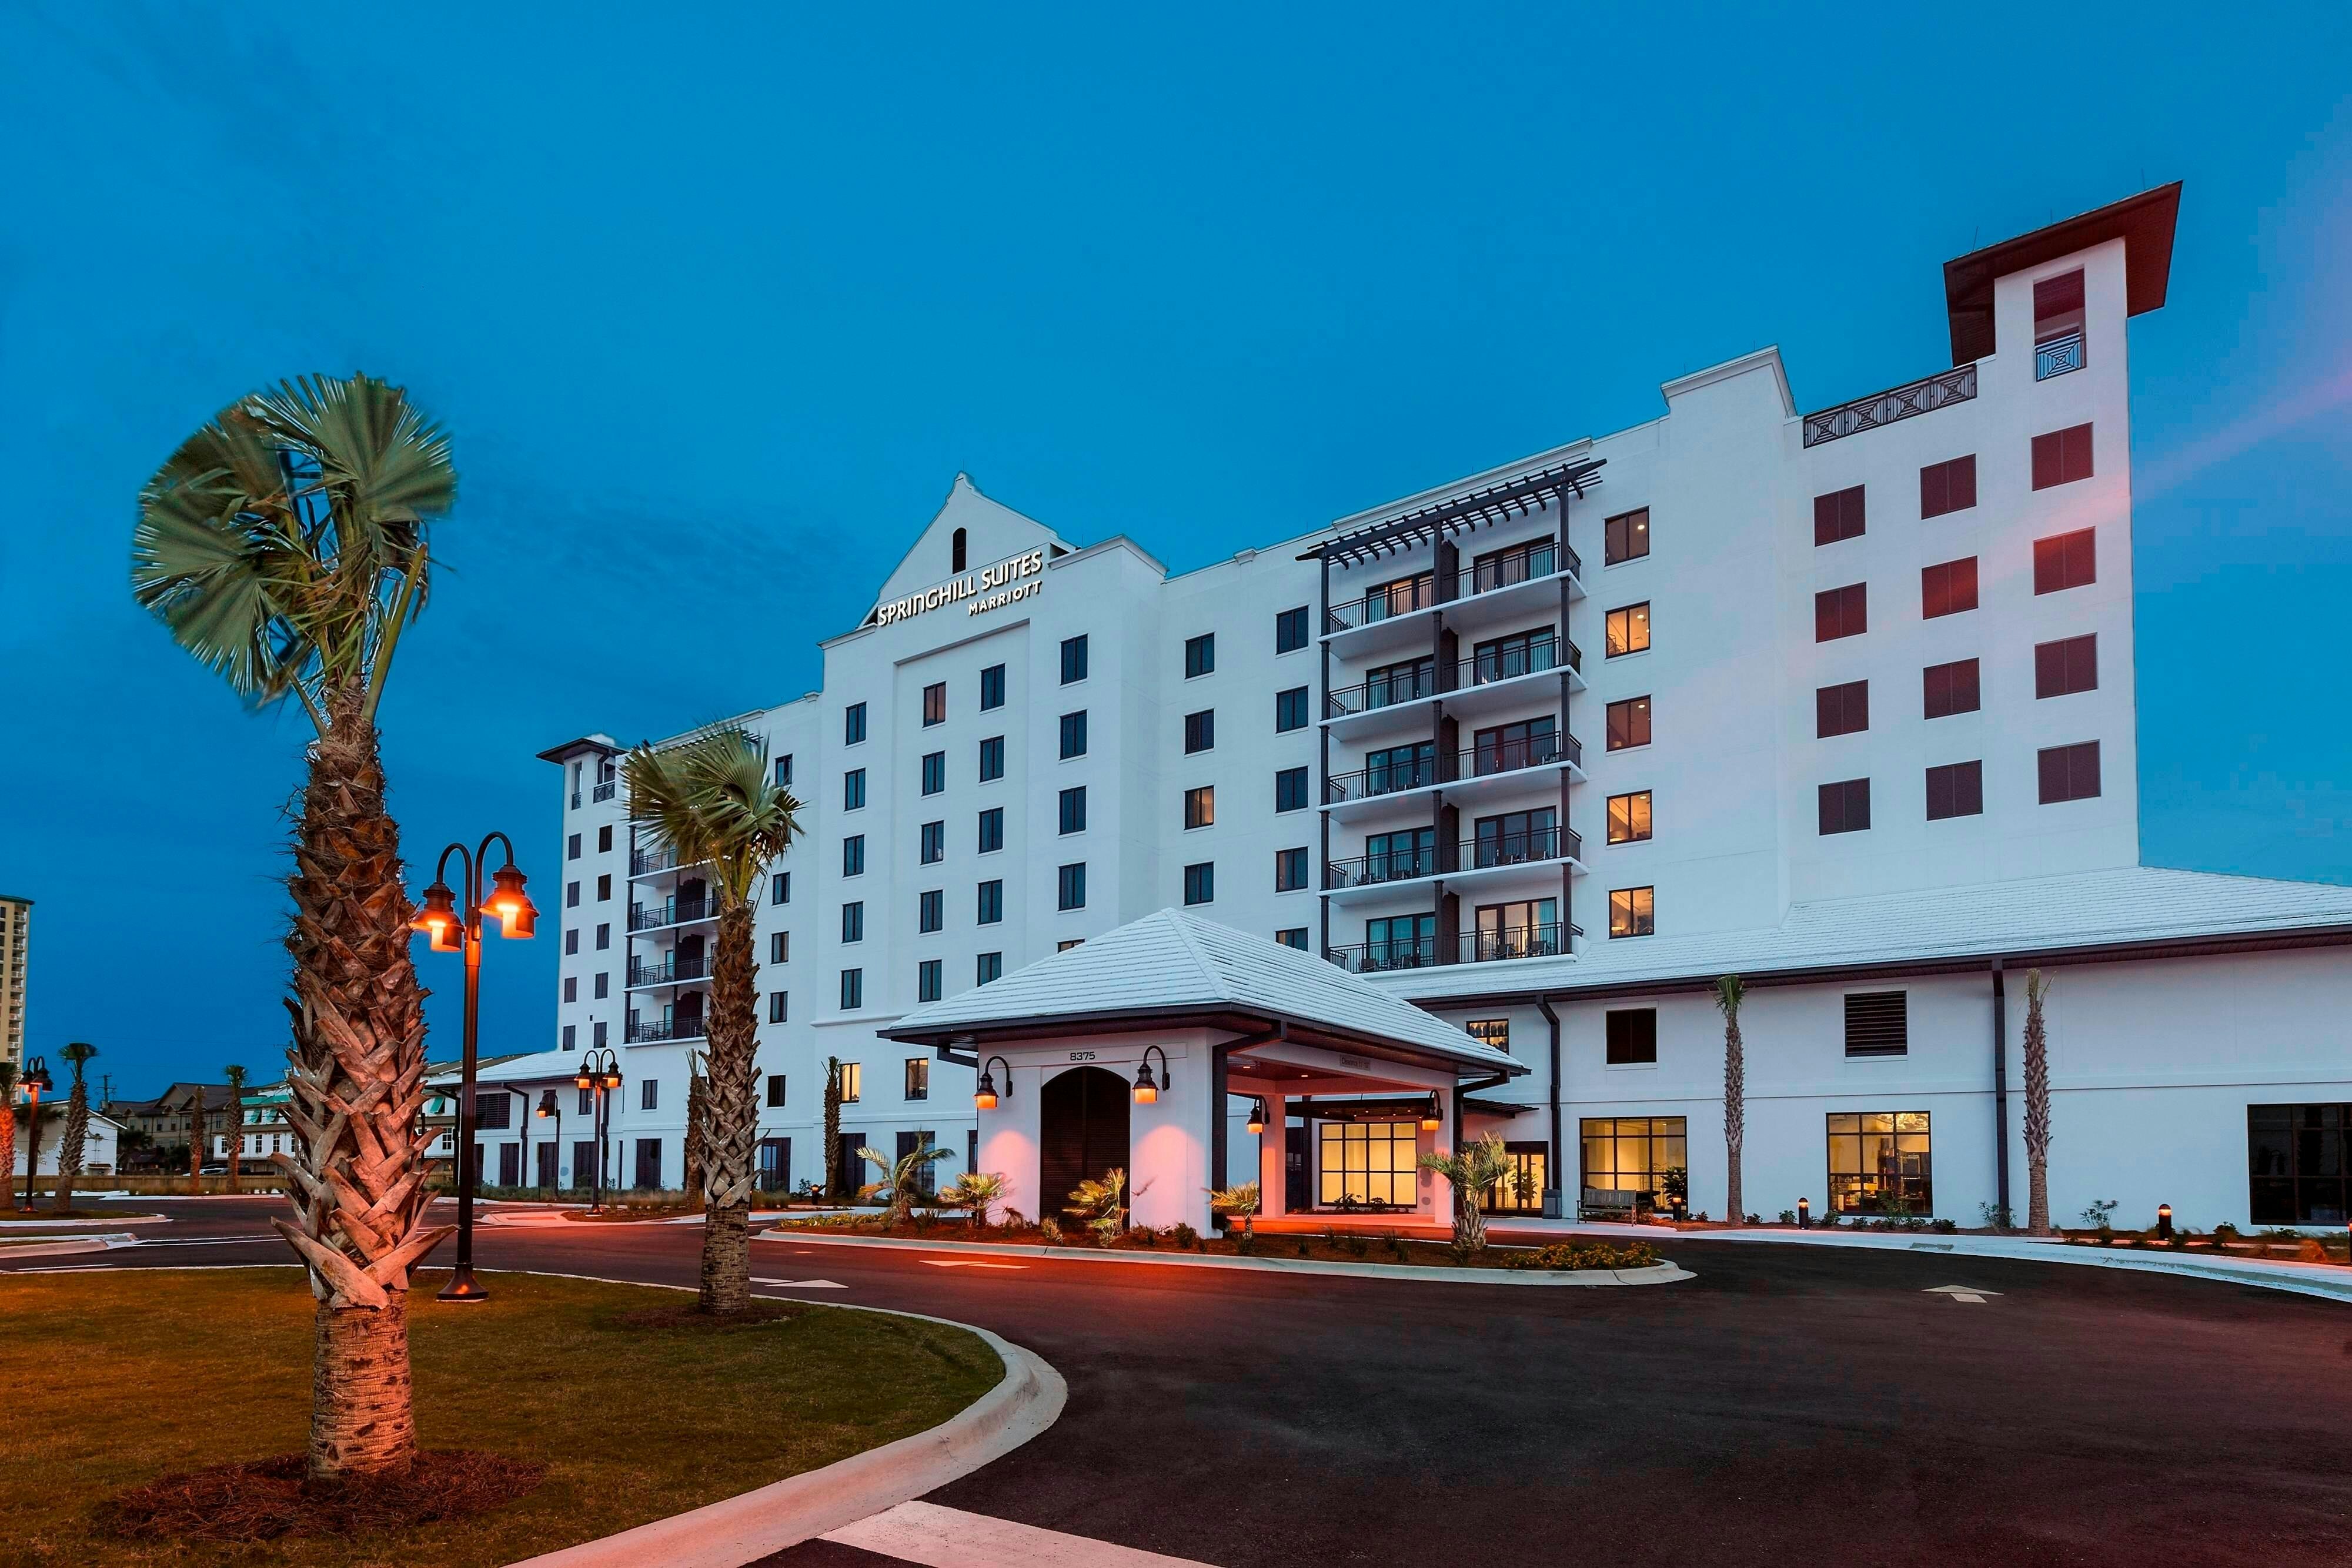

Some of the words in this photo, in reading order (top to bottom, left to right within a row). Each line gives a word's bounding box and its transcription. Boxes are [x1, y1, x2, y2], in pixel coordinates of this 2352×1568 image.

[878, 576, 978, 626] SPRINGHILL
[981, 551, 1043, 590] SUITES
[968, 580, 1043, 616] MARRIOTT
[1070, 1051, 1095, 1061] 8375
